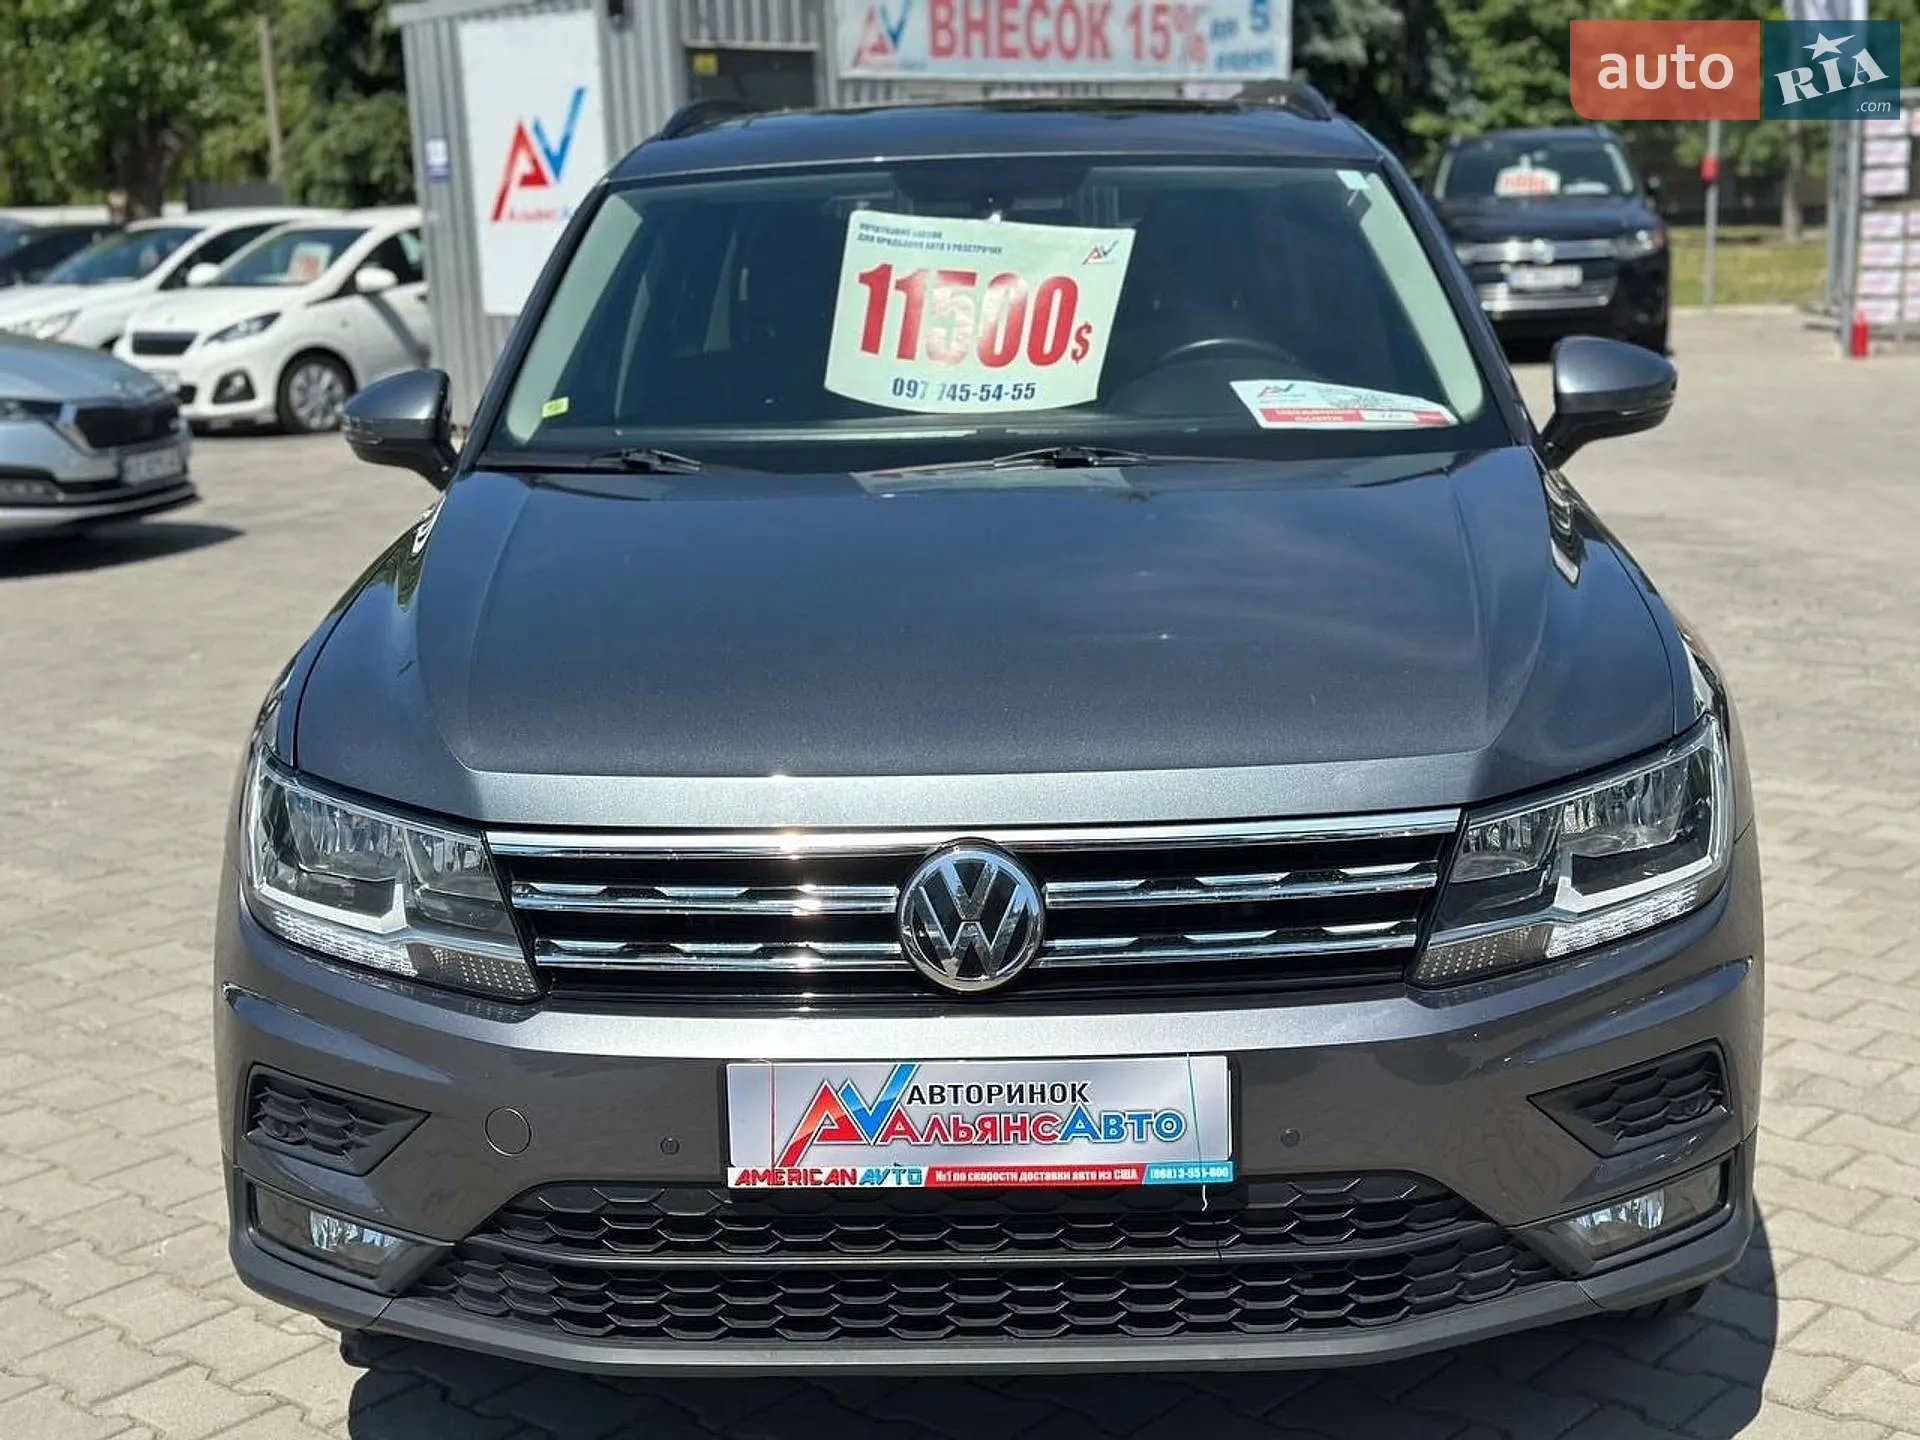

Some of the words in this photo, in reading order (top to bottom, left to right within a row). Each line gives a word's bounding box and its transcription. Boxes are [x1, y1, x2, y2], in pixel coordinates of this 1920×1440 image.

[929, 0, 1112, 60] ВНЕСОК
[892, 376, 929, 399] 097
[938, 381, 1037, 402] 745-54-55
[906, 1081, 1090, 1106] АВТОРИНОК
[735, 1168, 857, 1187] AMERICAN
[953, 1171, 966, 1182] по
[967, 1170, 1018, 1183] скорости
[1019, 1170, 1070, 1183] доставки
[1072, 1170, 1097, 1182] авто
[1113, 1168, 1138, 1181] США
